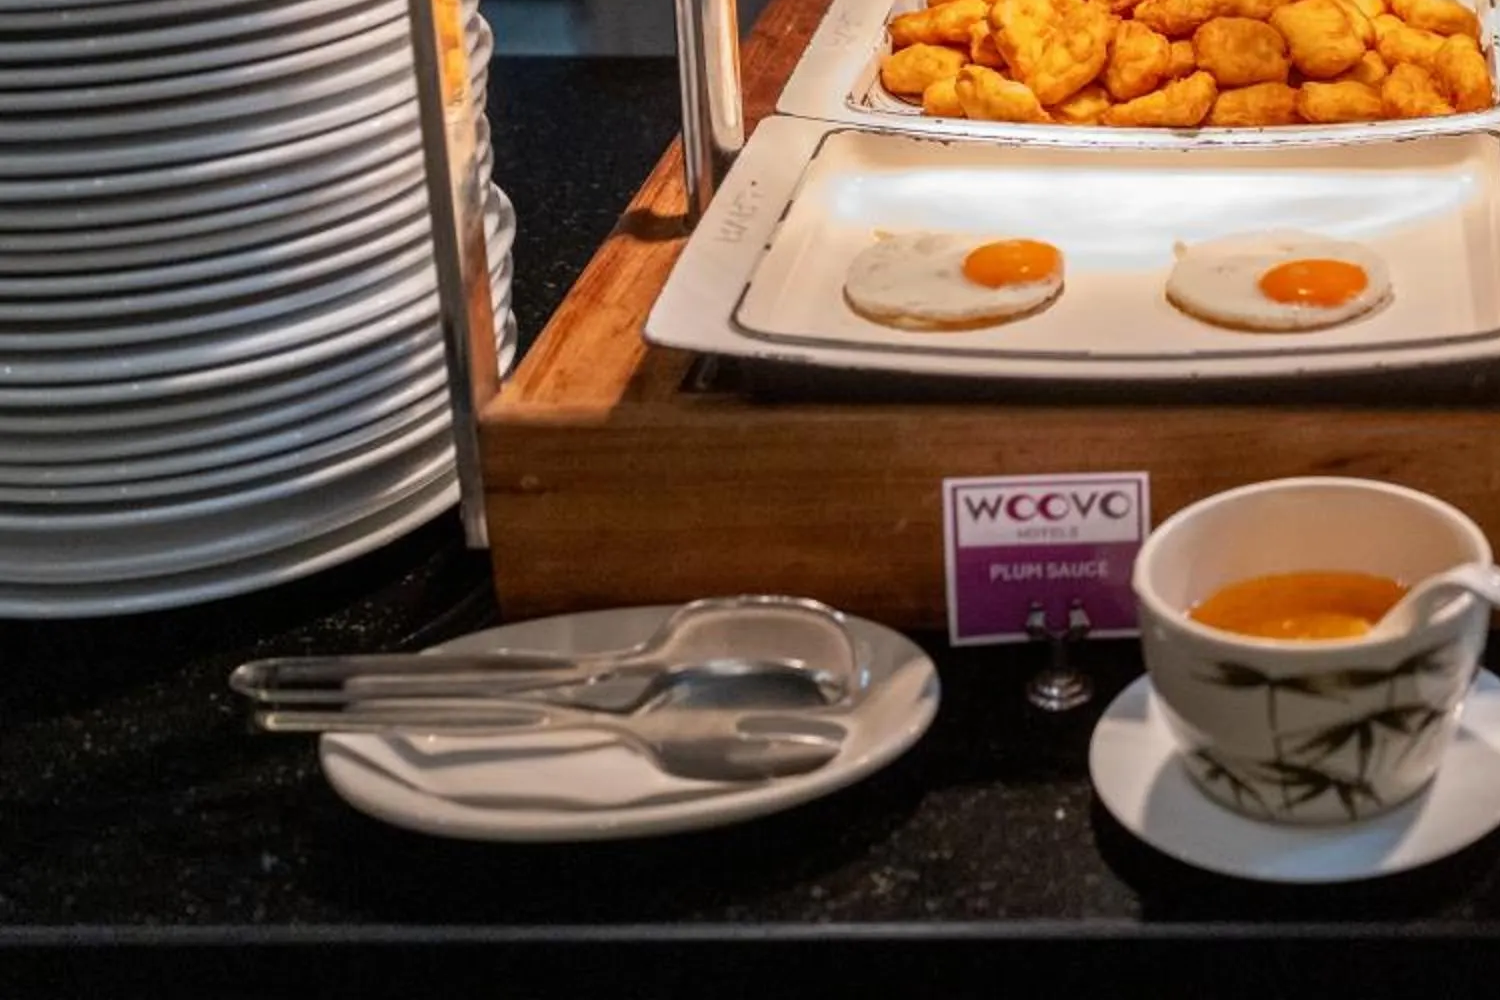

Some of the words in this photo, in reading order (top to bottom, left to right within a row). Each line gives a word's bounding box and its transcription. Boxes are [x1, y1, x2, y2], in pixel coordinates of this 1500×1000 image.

[964, 490, 1132, 521] WOOVO
[989, 563, 1043, 583] PLUM
[1046, 560, 1109, 580] SAUCE
